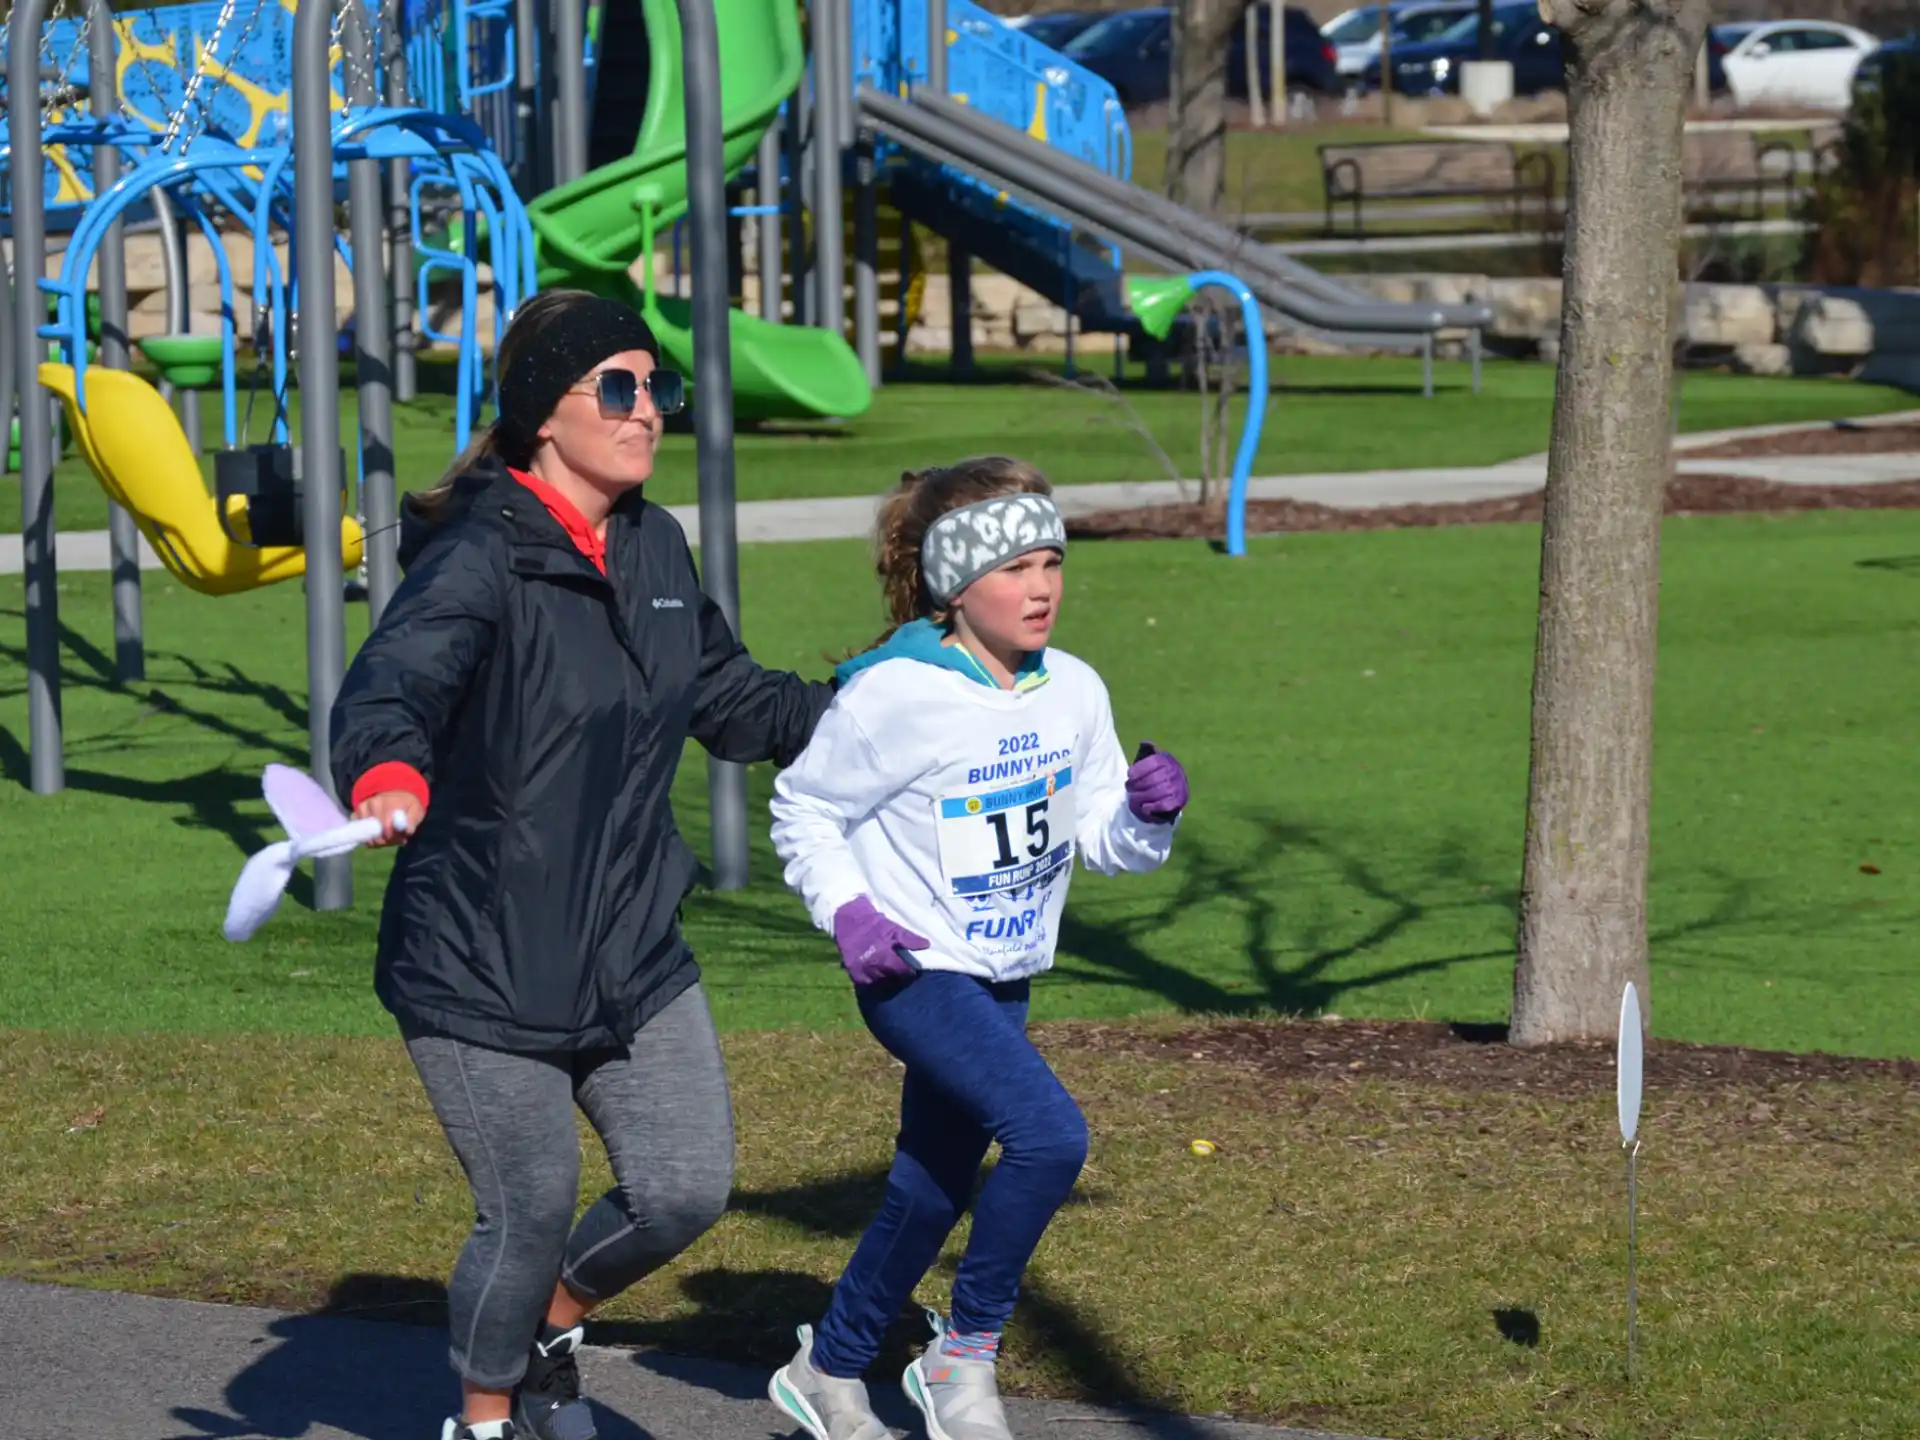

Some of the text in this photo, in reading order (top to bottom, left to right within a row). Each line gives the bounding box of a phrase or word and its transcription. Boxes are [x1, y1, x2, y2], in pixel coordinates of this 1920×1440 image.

[998, 732, 1040, 756] 2022
[968, 756, 1033, 784] BUNNY
[985, 790, 1024, 808] BUNNY
[985, 799, 1050, 869] 15
[988, 869, 1012, 888] FUN
